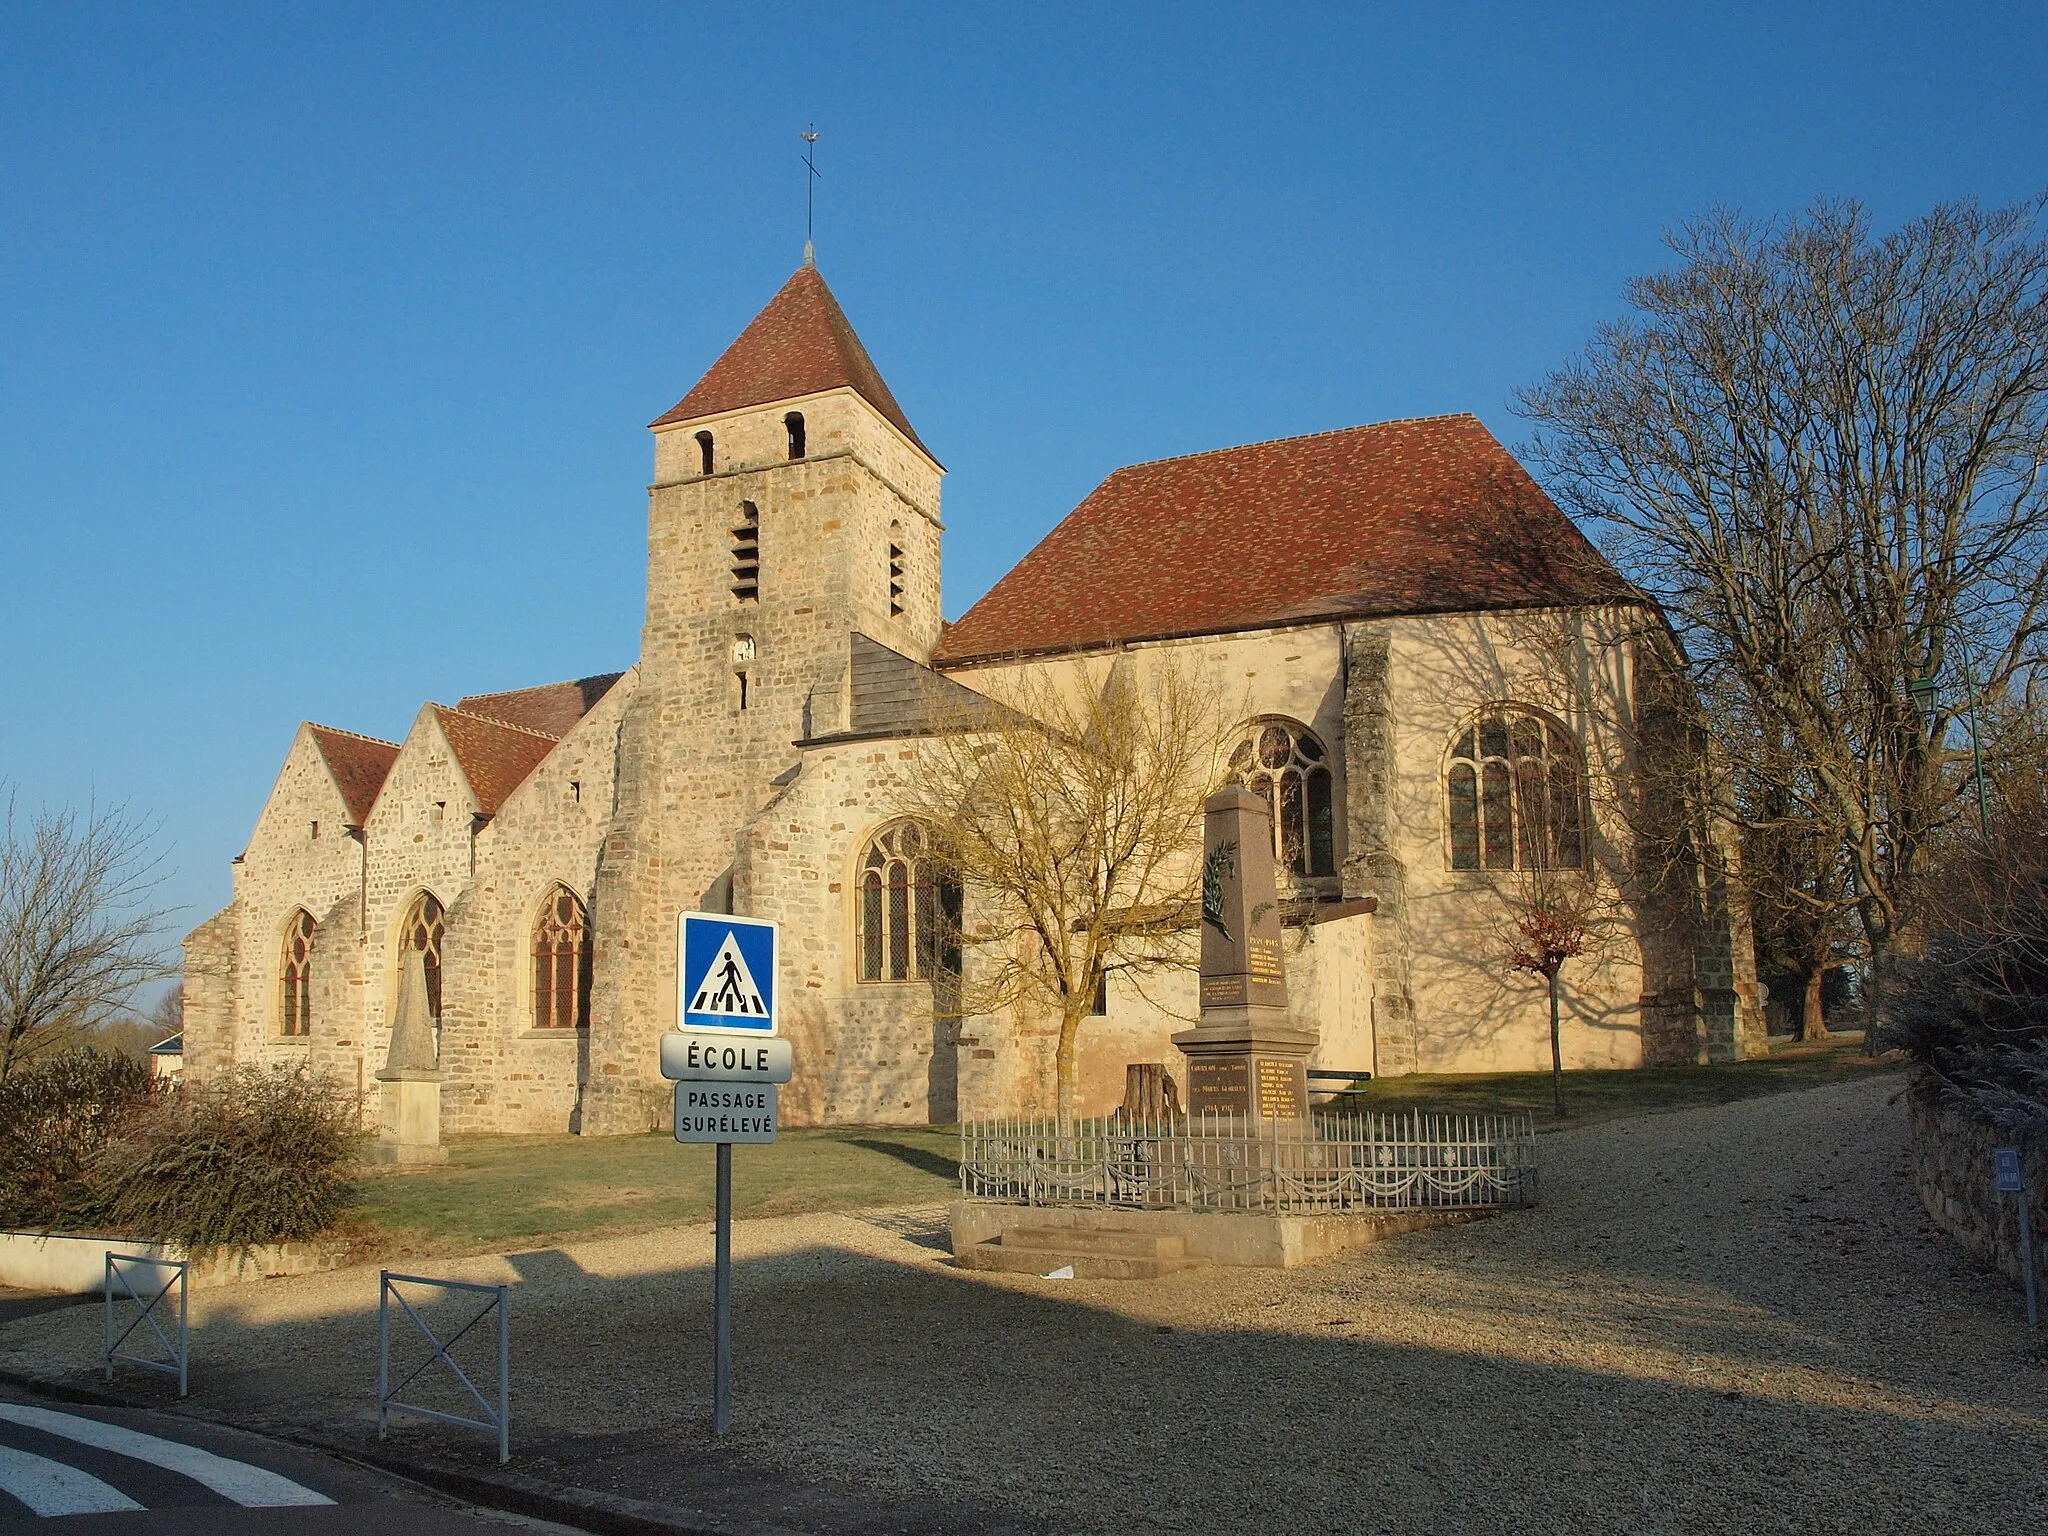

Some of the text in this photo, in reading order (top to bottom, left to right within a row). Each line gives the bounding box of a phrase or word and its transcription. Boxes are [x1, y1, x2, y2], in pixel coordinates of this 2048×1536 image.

[688, 1041, 769, 1071] ÉCOLE
[688, 1092, 766, 1109] PASSAGE
[682, 1115, 772, 1133] SURÉLEVÉ
